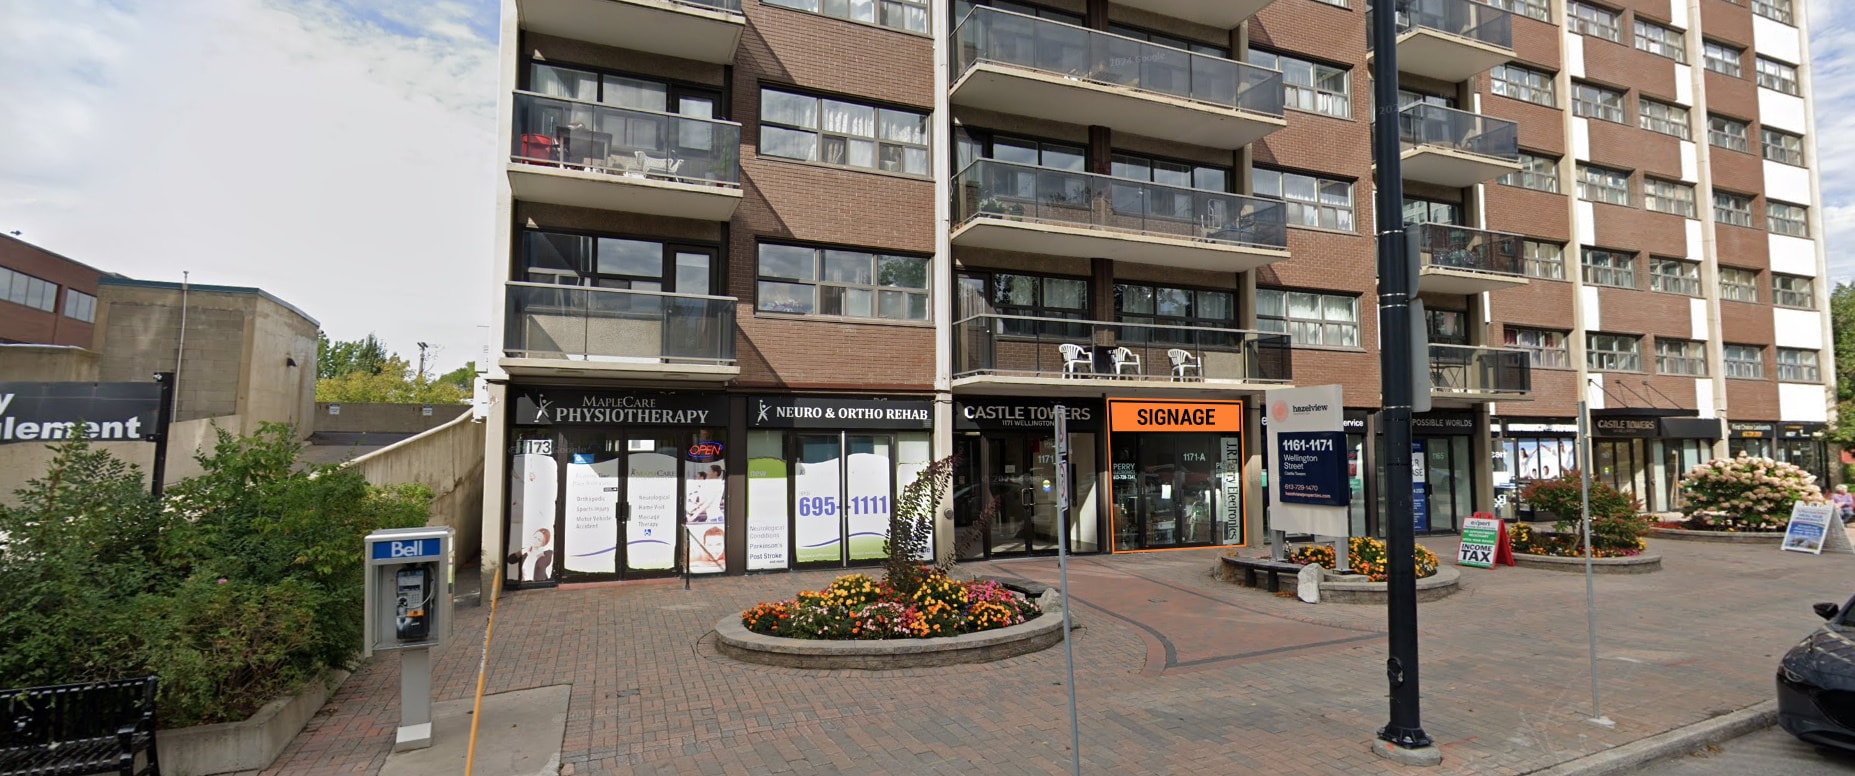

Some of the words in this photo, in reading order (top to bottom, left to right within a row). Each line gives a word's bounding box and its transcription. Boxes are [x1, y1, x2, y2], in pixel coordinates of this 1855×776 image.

[776, 406, 822, 418] NEURO
[825, 408, 836, 418] &
[838, 408, 884, 420] ORTHO
[886, 409, 928, 420] REHAB
[964, 406, 1024, 420] CASTLE
[1292, 404, 1328, 413] hazelview
[556, 408, 709, 424] PHYSIOTHERAPY
[0, 416, 141, 440] lement
[1342, 419, 1364, 427] ervice
[1412, 418, 1444, 427] POSSIBLE
[1446, 419, 1473, 427] WORLDS
[1598, 420, 1625, 429] CASTLE
[1627, 420, 1655, 430] TOWERS
[689, 444, 721, 456] OPEN
[1282, 439, 1334, 452] 1161-1171
[1038, 455, 1055, 465] 1171
[1183, 452, 1206, 462] 1171-A
[1283, 454, 1318, 464] Wellington
[1284, 462, 1305, 471] Street
[1228, 486, 1240, 540] Electronics
[392, 541, 423, 557] Bell
[1461, 544, 1493, 552] INCOME
[1461, 550, 1491, 562] TAX
